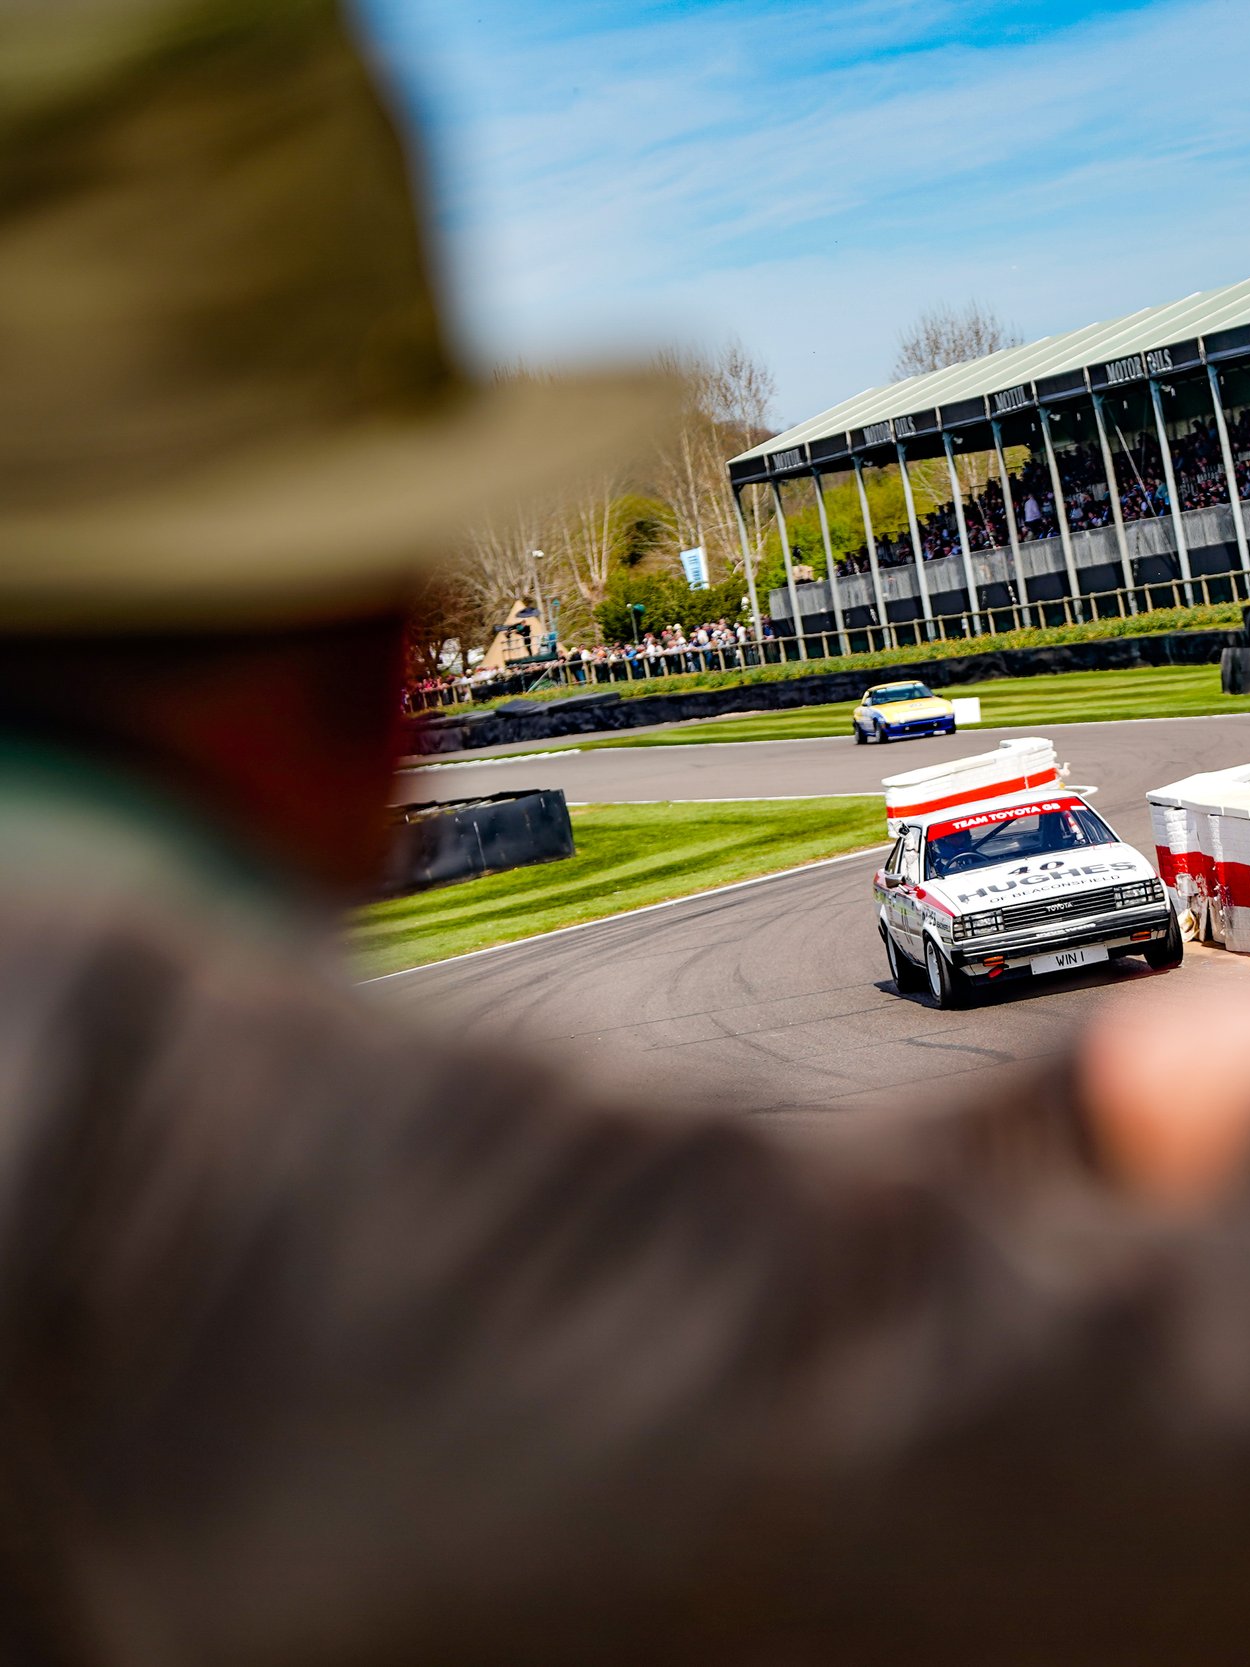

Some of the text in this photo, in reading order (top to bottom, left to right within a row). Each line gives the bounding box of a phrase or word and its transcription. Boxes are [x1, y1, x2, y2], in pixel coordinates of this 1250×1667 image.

[1105, 356, 1145, 385] MOTOR
[952, 802, 1062, 830] TEAM TOYOTA GB
[1007, 860, 1066, 876] 40
[957, 861, 1138, 904] HUGHES
[990, 874, 1121, 903] OF BEACONSFIELD
[1045, 902, 1074, 913] TOYOTA
[1055, 952, 1078, 967] WIN
